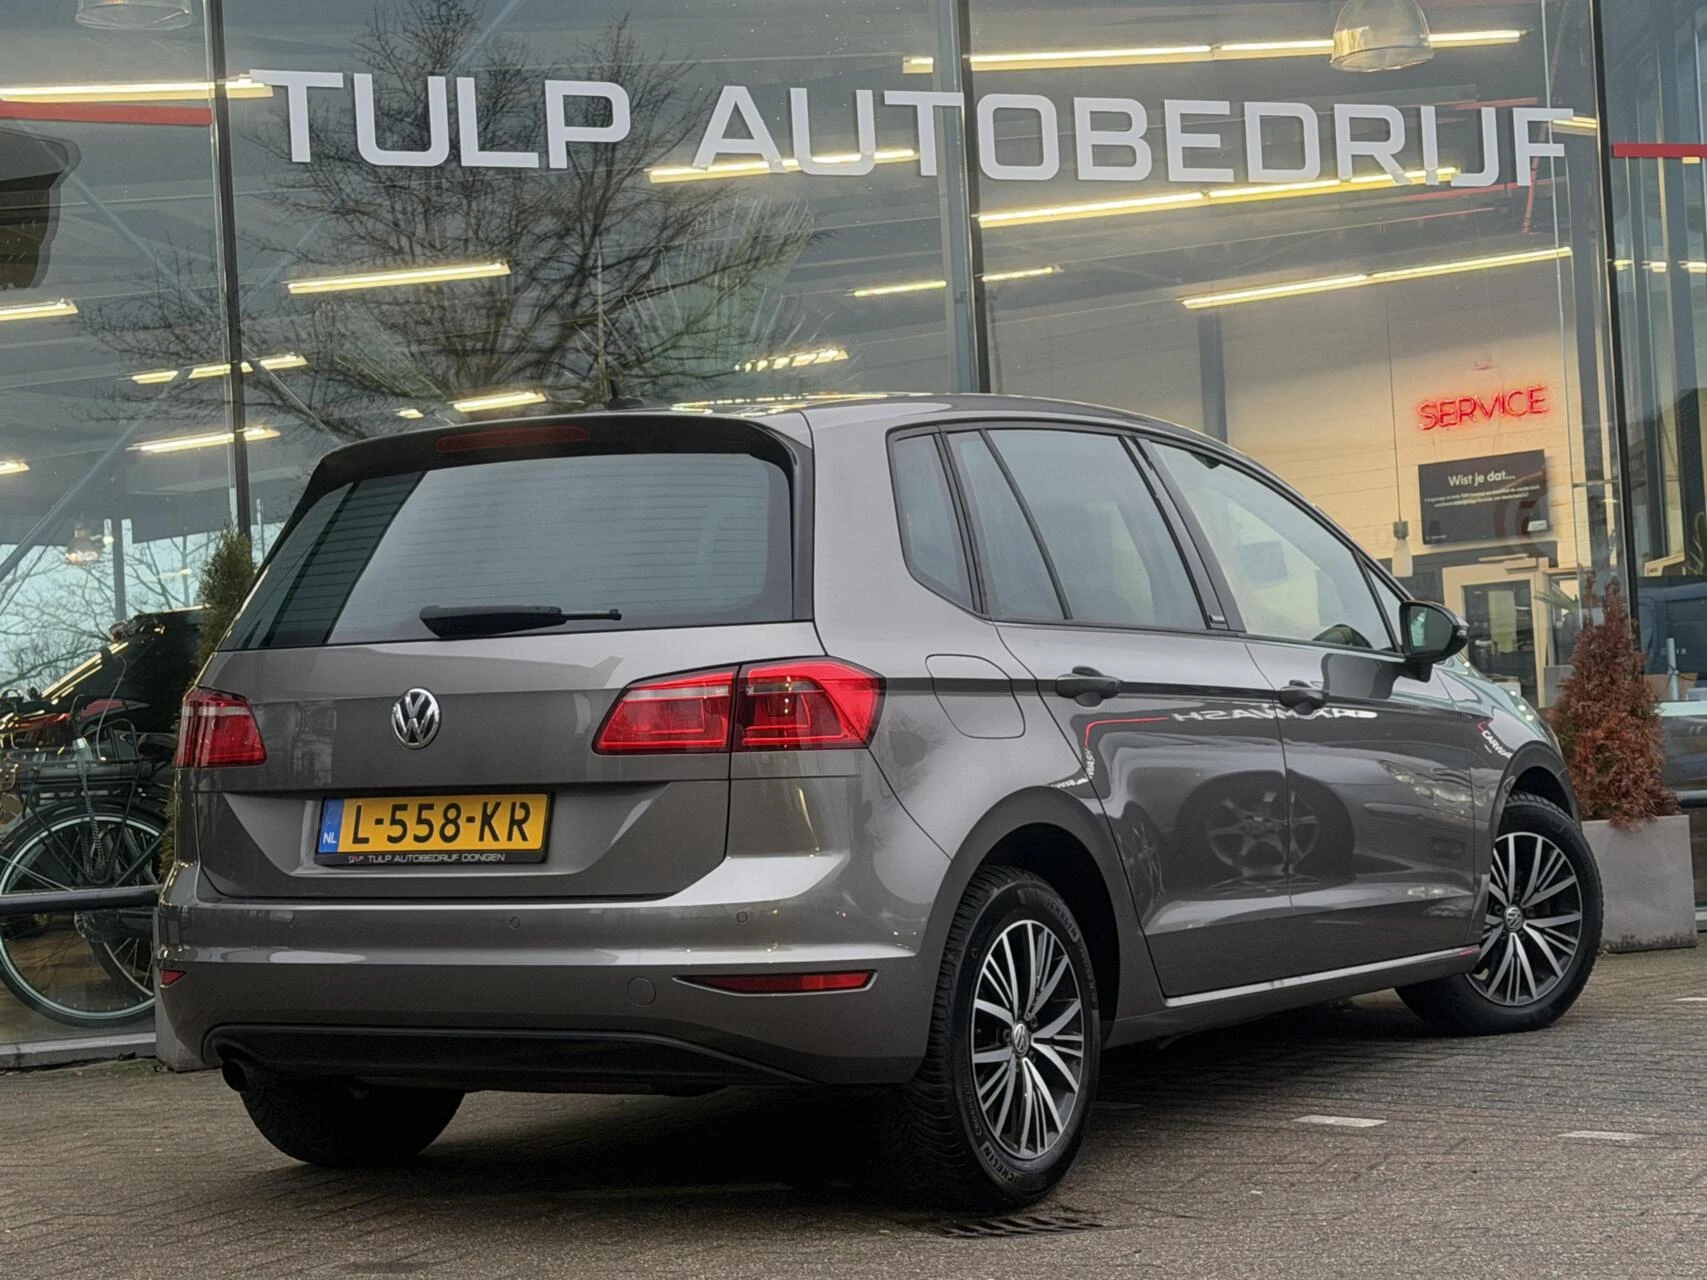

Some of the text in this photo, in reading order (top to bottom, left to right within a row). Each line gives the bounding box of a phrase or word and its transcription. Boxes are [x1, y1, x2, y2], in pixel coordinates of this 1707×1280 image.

[250, 69, 1574, 188] TULP AUTOBEDRIJF
[1418, 385, 1549, 432] SERVICE
[1448, 474, 1472, 488] Wist
[1473, 471, 1486, 488] je
[323, 831, 337, 844] NL
[351, 801, 531, 845] L-558-KR
[368, 854, 392, 864] TULP
[393, 853, 460, 863] AUTOBEDRIJF
[461, 853, 506, 863] DONGEN
